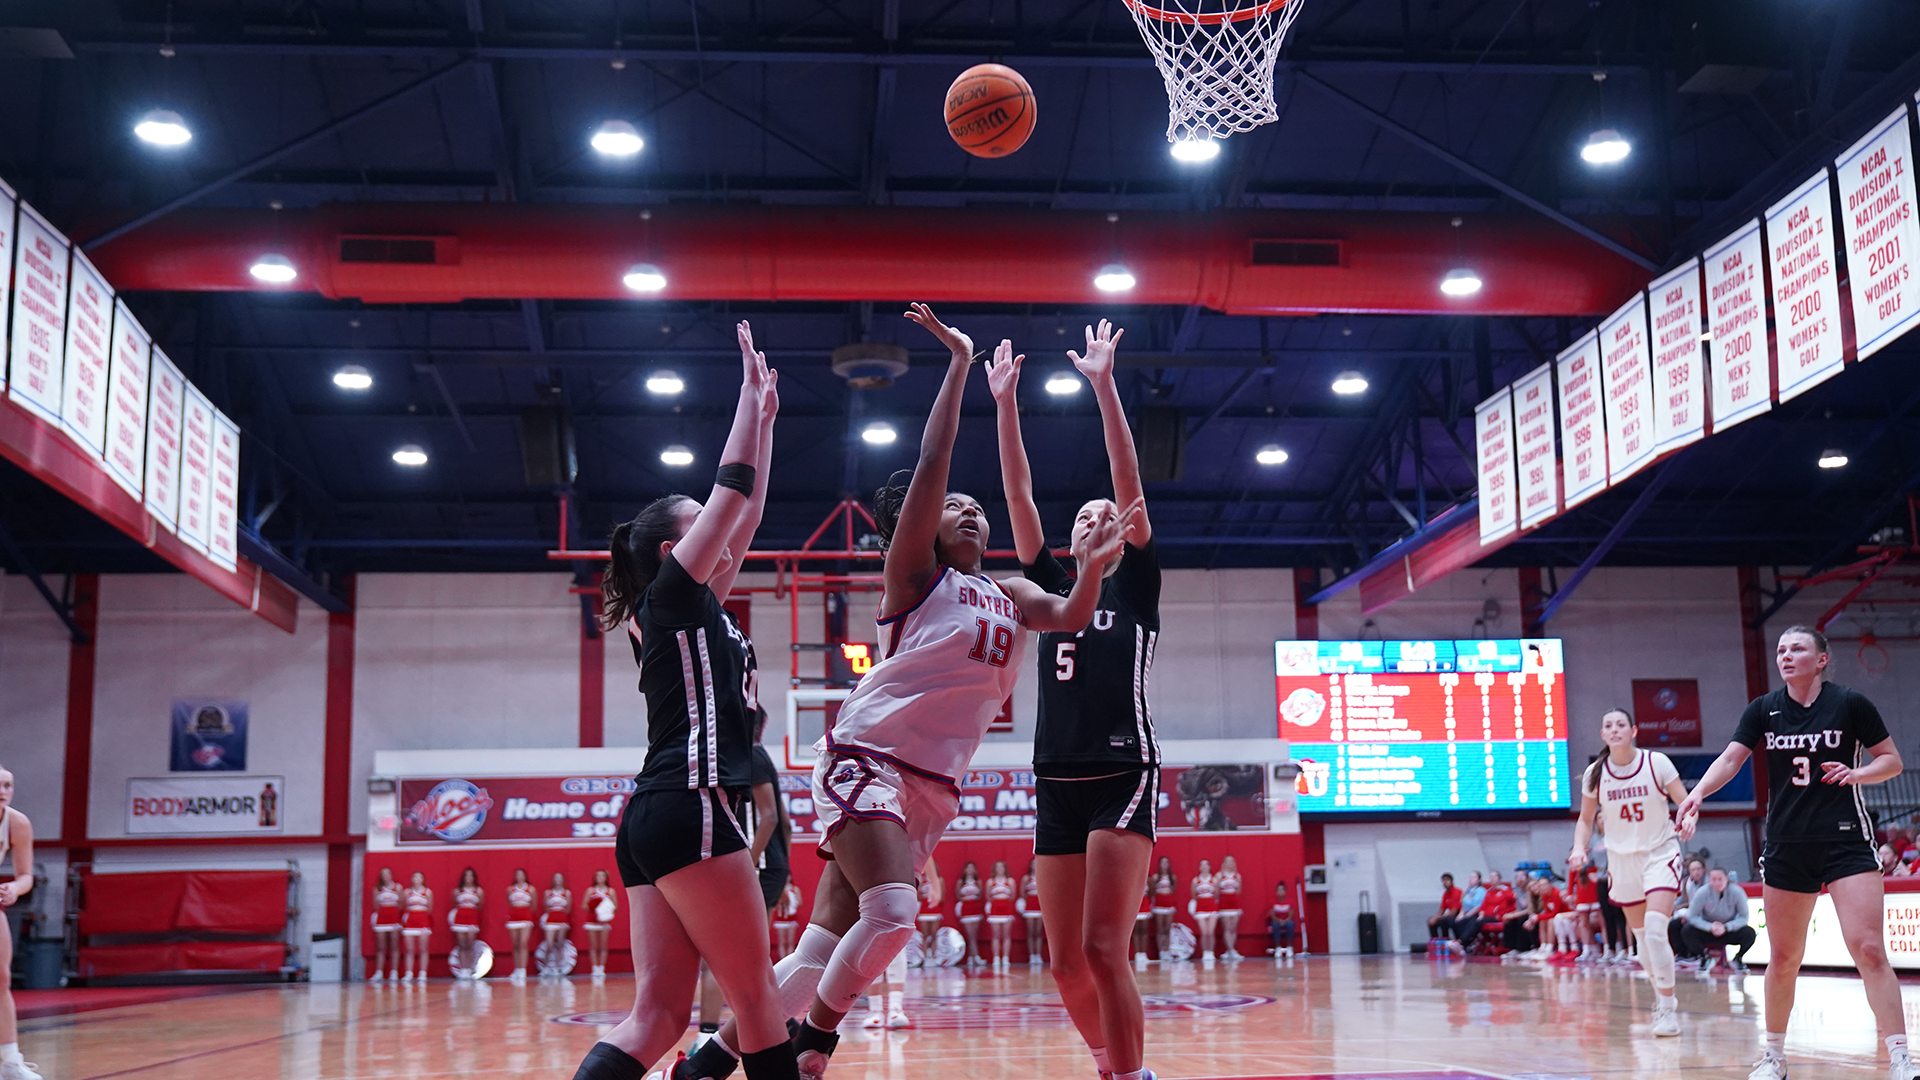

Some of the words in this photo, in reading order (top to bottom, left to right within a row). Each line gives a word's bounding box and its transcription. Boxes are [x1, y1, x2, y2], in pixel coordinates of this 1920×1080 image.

[949, 84, 988, 113] NCAA
[952, 107, 1010, 138] Wilson
[1861, 146, 1887, 179] NCAA
[1849, 164, 1892, 211] DIVISION
[1893, 156, 1904, 177] II
[1787, 205, 1810, 231] NCAA
[1855, 184, 1901, 229] NATIONAL
[1776, 225, 1814, 262] DIVISION
[1815, 217, 1824, 235] II
[1853, 202, 1910, 255] CHAMPIONS
[1722, 251, 1743, 275] NCAA
[1781, 242, 1821, 280] NATIONAL
[1868, 235, 1901, 277] 2001
[1665, 286, 1682, 306] NCAA
[1712, 268, 1747, 300] DIVISION
[1747, 264, 1755, 280] II
[1777, 260, 1829, 303] CHAMPIONS
[1864, 263, 1909, 305] WOMEN'S
[1656, 303, 1686, 330] DIVISION
[1686, 299, 1694, 314] II
[1717, 287, 1752, 319] NATIONAL
[1790, 290, 1821, 326] 2000
[1878, 292, 1901, 321] GOLF
[1615, 321, 1631, 343] NCAA
[1659, 321, 1691, 347] NATIONAL
[1713, 305, 1759, 341] CHAMPIONS
[1788, 316, 1828, 351] WOMEN'S
[1607, 343, 1634, 367] DIVISION
[1656, 338, 1696, 369] CHAMPIONS
[1724, 331, 1752, 363] 2000
[1800, 343, 1821, 367] GOLF
[1612, 353, 1639, 382] NATIONAL
[1668, 362, 1689, 389] 1999
[1728, 360, 1751, 383] MEN'S
[1610, 366, 1644, 402] CHAMPIONS
[1731, 381, 1750, 402] GOLF
[1669, 389, 1689, 410] MEN'S
[1622, 417, 1640, 439] MEN'S
[1672, 408, 1689, 428] GOLF
[1626, 435, 1640, 456] GOLF
[1093, 609, 1116, 631] U
[968, 616, 1015, 669] 19
[1055, 641, 1076, 682] 5
[1764, 731, 1822, 753] Barry
[1822, 730, 1843, 749] U
[1791, 755, 1811, 787] 3
[133, 797, 257, 816] BODYARMOR
[502, 797, 586, 820] Home
[590, 794, 625, 818] of
[1607, 785, 1649, 802] SOUTHERN
[1619, 802, 1645, 823] 45
[572, 821, 617, 837] 30
[1890, 940, 1920, 953] COL
